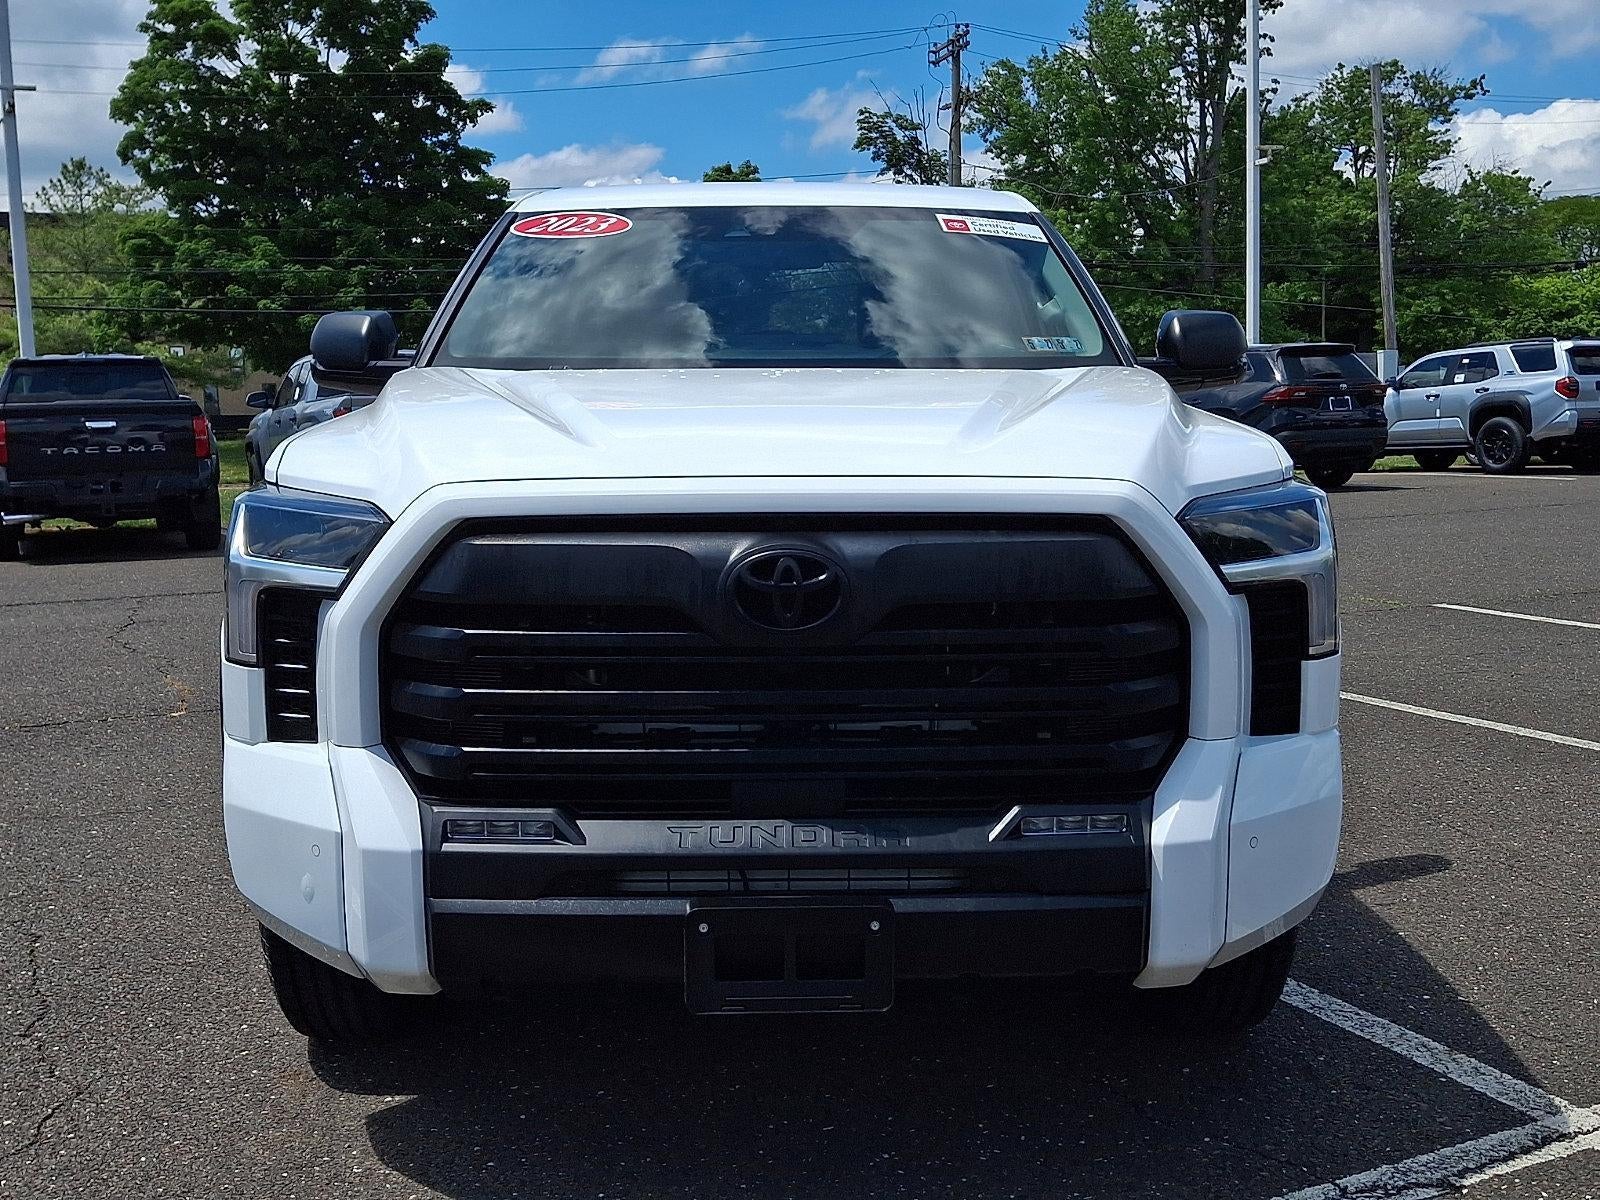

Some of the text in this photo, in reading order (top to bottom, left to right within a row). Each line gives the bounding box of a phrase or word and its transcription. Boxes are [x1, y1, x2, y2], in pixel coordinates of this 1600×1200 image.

[524, 216, 618, 233] 2023
[970, 220, 1016, 231] Certified
[972, 227, 1043, 240] Used Vehicles
[40, 444, 166, 455] TACOMA
[666, 824, 911, 849] TUNDRA
